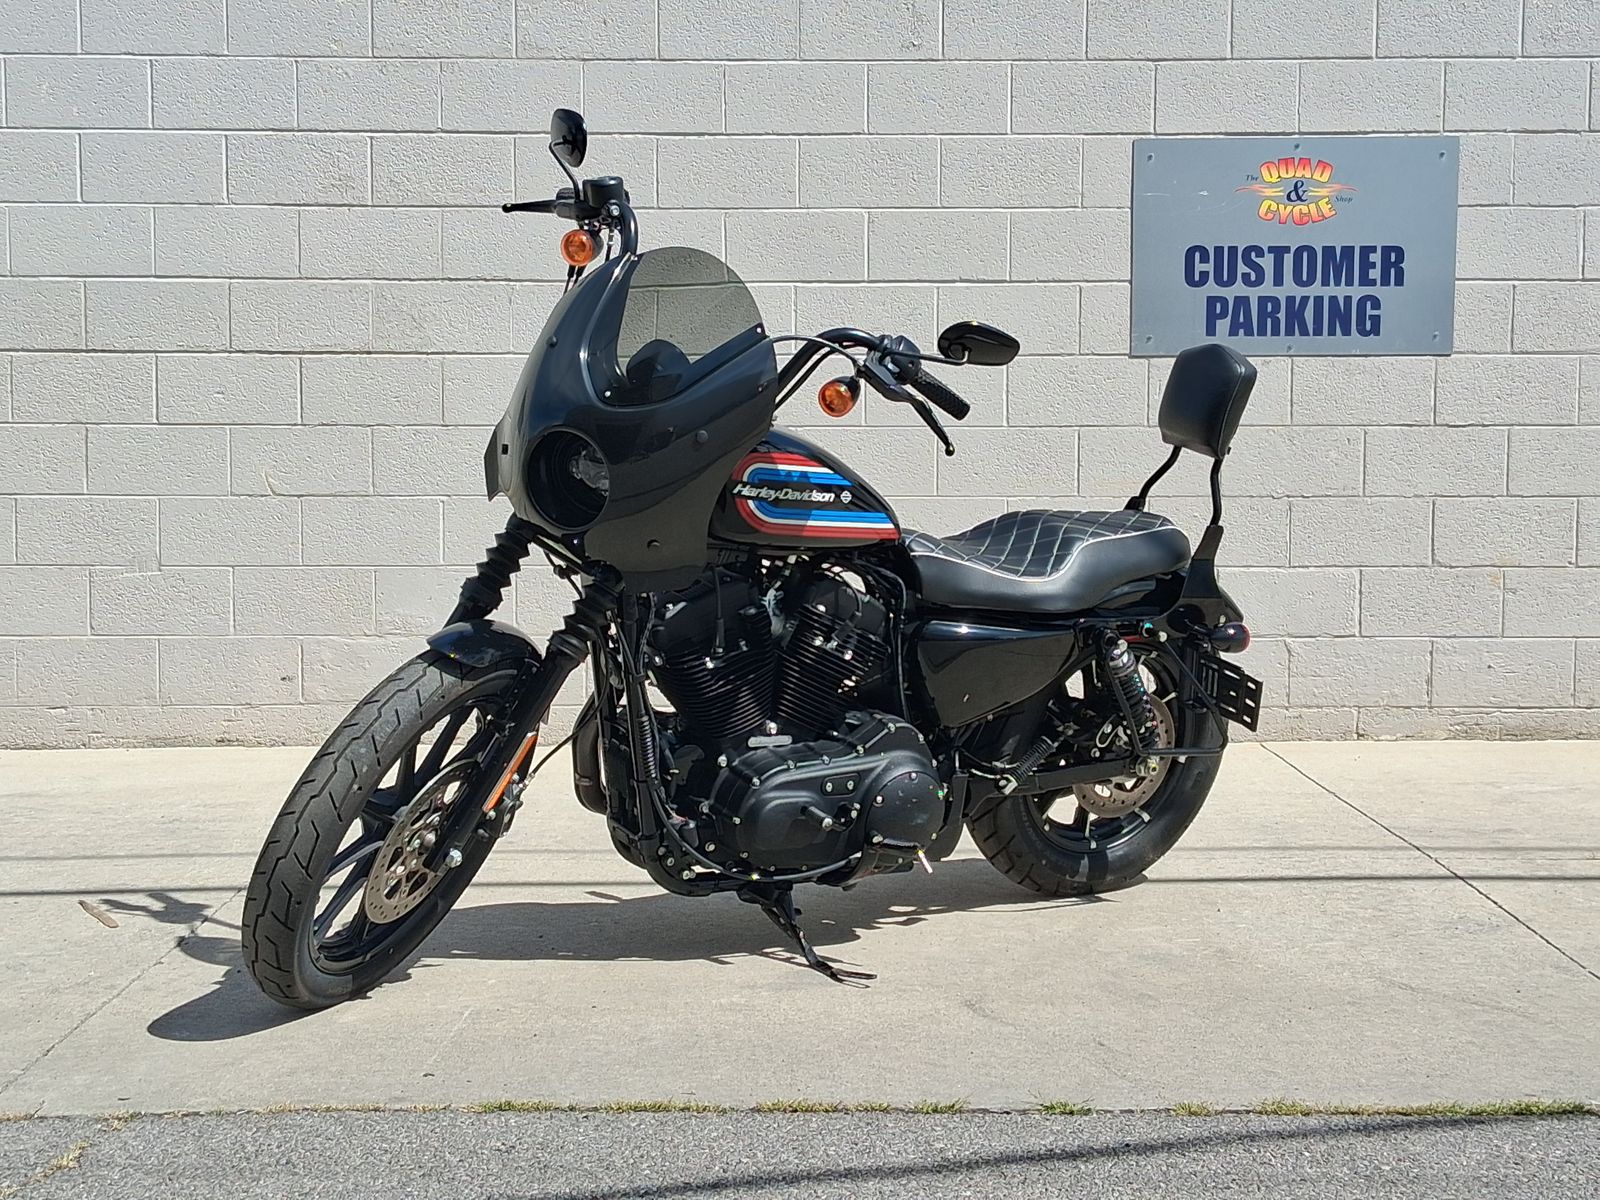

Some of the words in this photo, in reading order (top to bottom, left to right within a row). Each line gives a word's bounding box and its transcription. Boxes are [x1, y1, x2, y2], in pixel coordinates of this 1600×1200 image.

[1245, 174, 1259, 182] The
[1259, 157, 1334, 183] QUAD
[1286, 180, 1308, 203] &
[1334, 195, 1354, 204] Shop
[1258, 196, 1337, 226] CYCLE
[1184, 245, 1405, 288] CUSTOMER
[1205, 294, 1382, 338] PARKING
